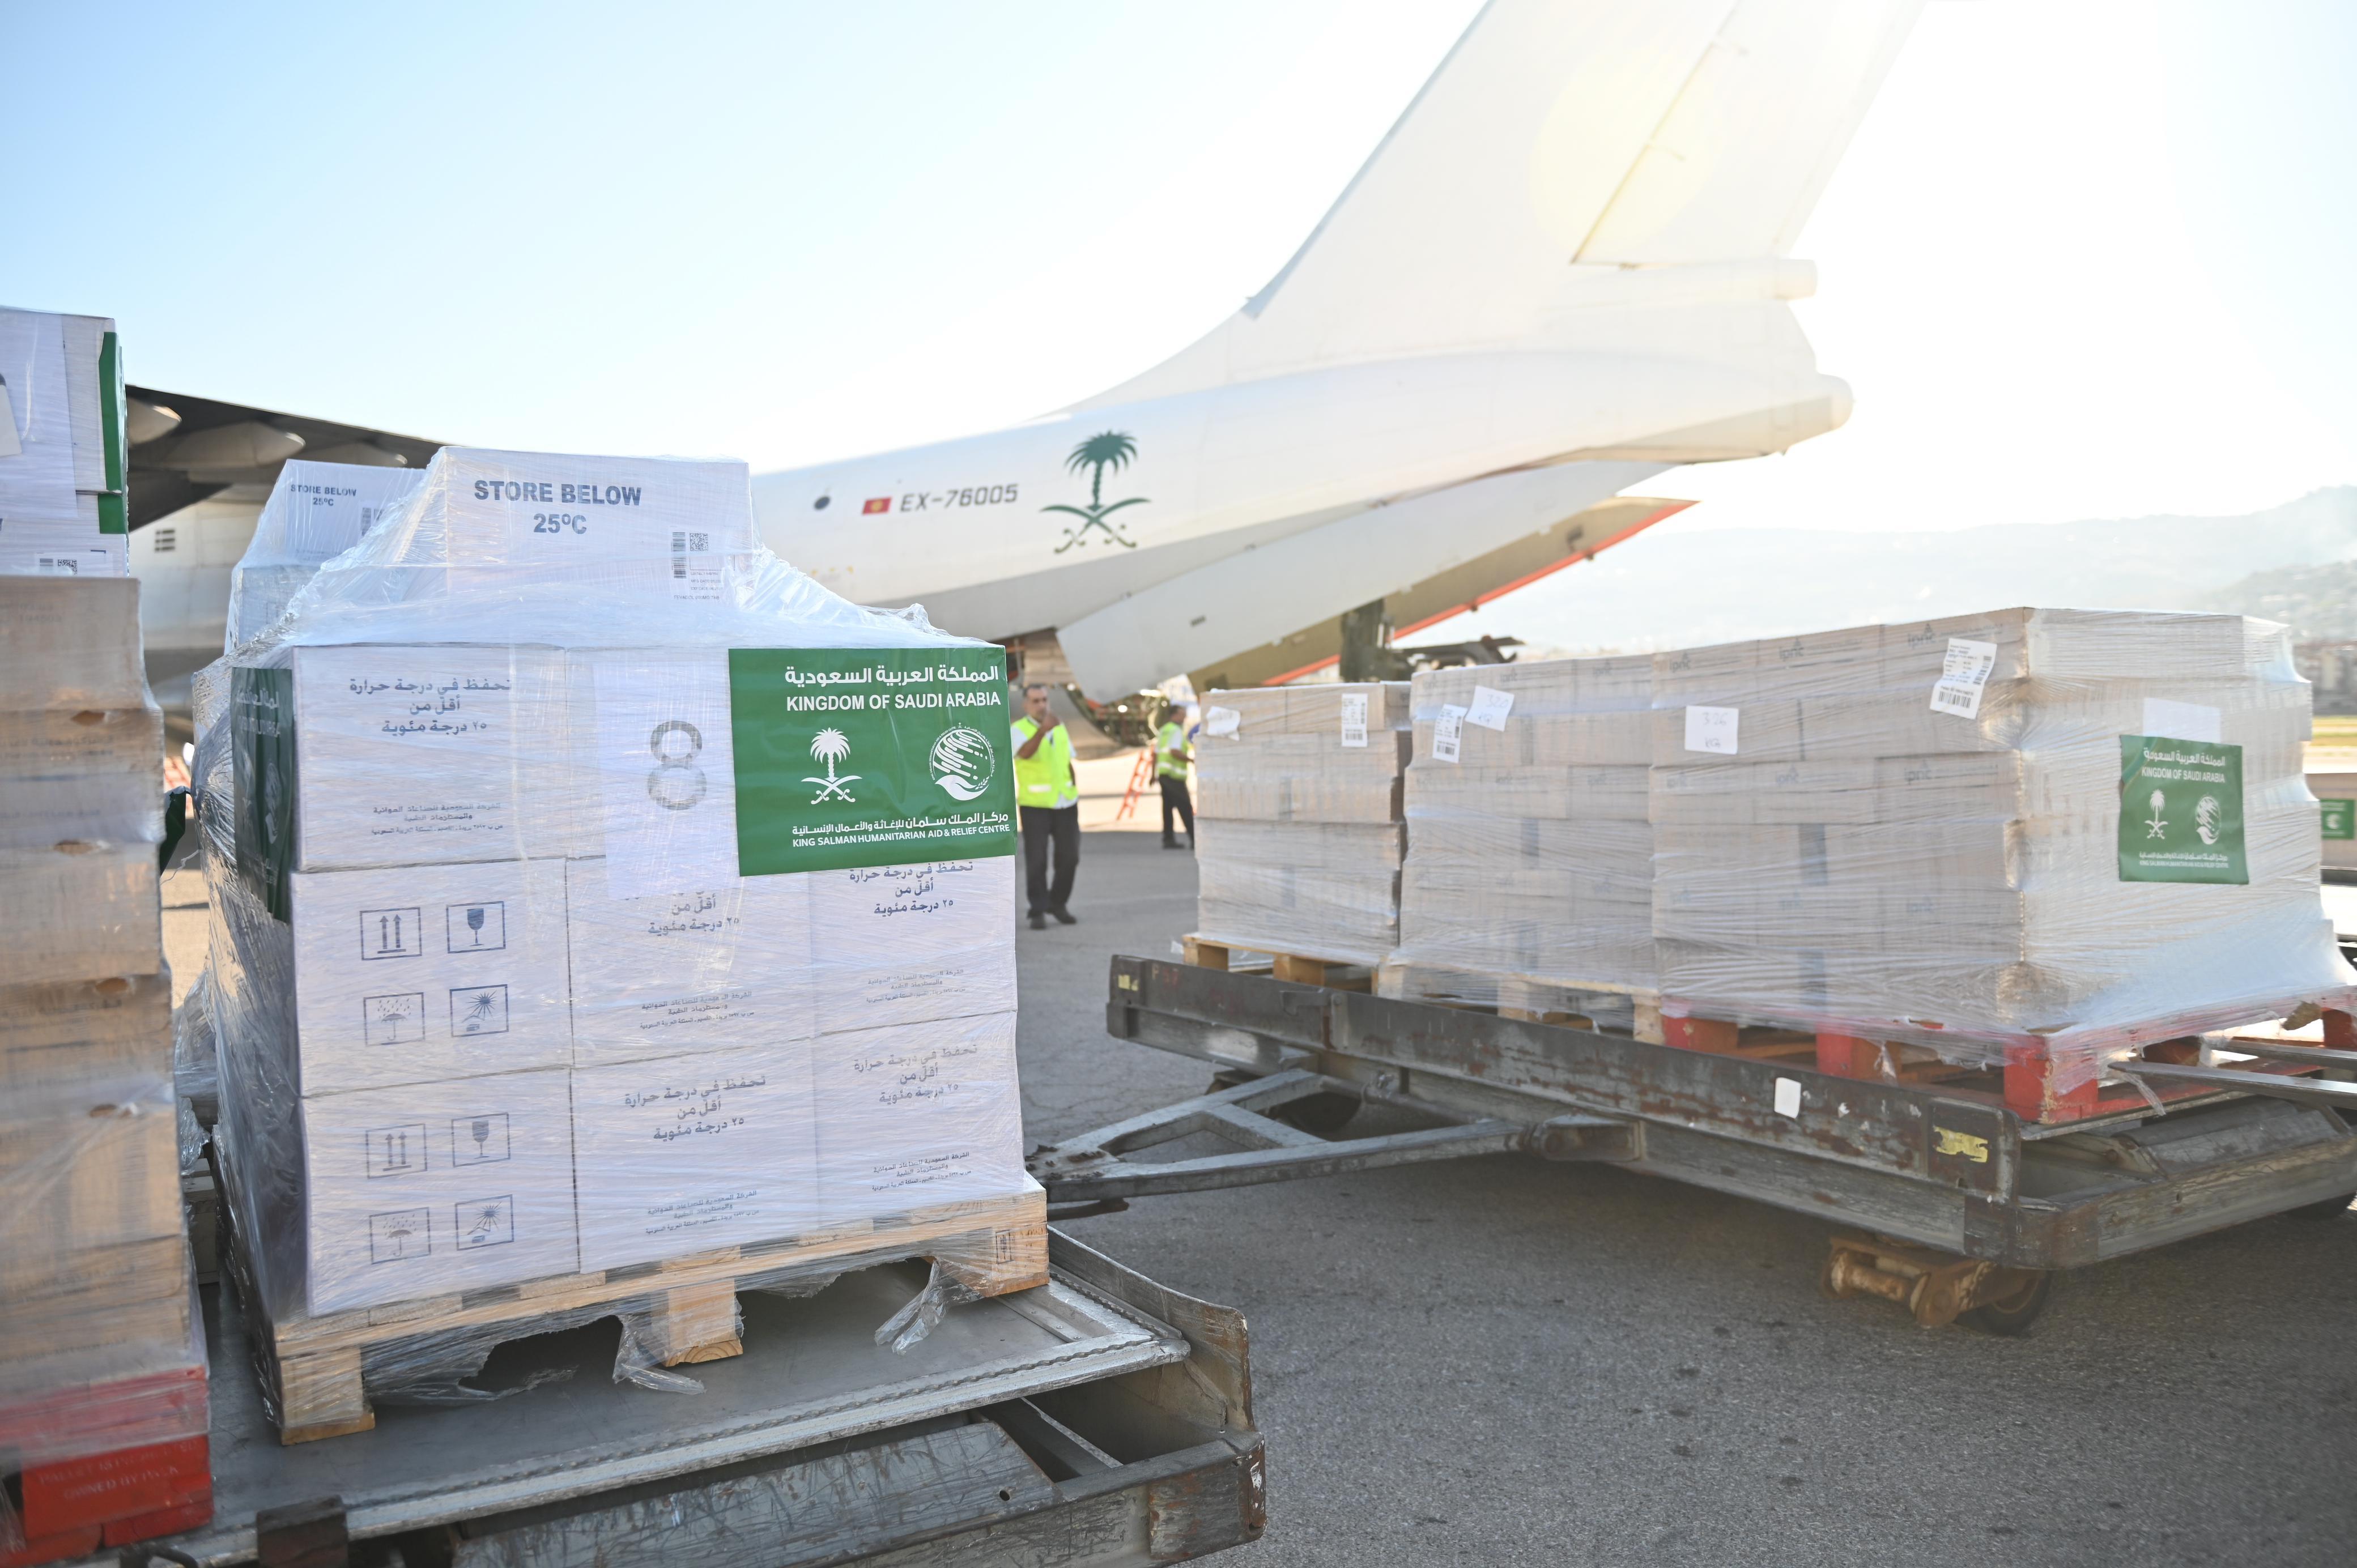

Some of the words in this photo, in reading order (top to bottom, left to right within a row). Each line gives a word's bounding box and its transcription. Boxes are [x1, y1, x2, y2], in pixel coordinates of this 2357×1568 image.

[290, 484, 321, 494] STORE
[324, 487, 357, 496] BELOW
[474, 480, 554, 502] STORE
[561, 483, 642, 506] BELOW
[900, 484, 1020, 513] EX-76005
[785, 666, 872, 688] السعودية
[876, 665, 934, 686] العربية
[938, 664, 999, 683] المملكة
[350, 679, 390, 694] حرارة
[394, 679, 433, 694] درجة
[787, 695, 865, 711] KINGDOM
[869, 694, 890, 709] OF
[895, 693, 942, 709] SAUDI
[945, 691, 1001, 708] ARABIA
[410, 703, 431, 715] من
[381, 721, 426, 736] مئوية
[429, 719, 467, 735] درجة
[2176, 750, 2200, 765] العربية
[2200, 752, 2226, 767] المملكة
[647, 720, 707, 811] 8
[2142, 766, 2172, 779] KINGDOM
[2173, 769, 2182, 779] OF
[2183, 770, 2202, 781] SAUDI
[2202, 772, 2225, 783] ARABIA
[874, 819, 904, 829] للإغاثة
[905, 816, 946, 829] سلمان
[947, 813, 980, 825] الملك
[981, 811, 1009, 825] مركز
[792, 823, 834, 837] الإنسانية
[835, 821, 873, 833] والأعمال
[793, 838, 816, 847] KING
[818, 835, 857, 845] SALMAN
[858, 830, 926, 843] HUMANITARIAN
[928, 829, 943, 838] AID
[951, 826, 977, 836] RELIEF
[978, 824, 1010, 834] CENTRE
[883, 867, 913, 879] درجة
[935, 862, 973, 874] تحفظ
[849, 869, 880, 883] حرارة
[895, 887, 912, 898] من
[672, 903, 691, 915] من
[874, 902, 907, 917] مئوية
[910, 900, 939, 913] درجة
[942, 898, 954, 907] ٢٥
[648, 921, 686, 936] مئوية
[689, 918, 722, 932] درجة
[941, 1045, 977, 1058] تحفظ
[854, 1058, 884, 1073] حرارة
[888, 1054, 917, 1066] درجة
[723, 1076, 766, 1090] تحفظ
[900, 1073, 916, 1085] من
[664, 1088, 697, 1101] درجة
[879, 1089, 912, 1105] مئوية
[915, 1086, 943, 1098] درجة
[625, 1092, 660, 1108] حرارة
[678, 1106, 696, 1120] من
[695, 1122, 728, 1134] درجة
[731, 1117, 744, 1126] ٢٥
[653, 1125, 692, 1142] مئوية
